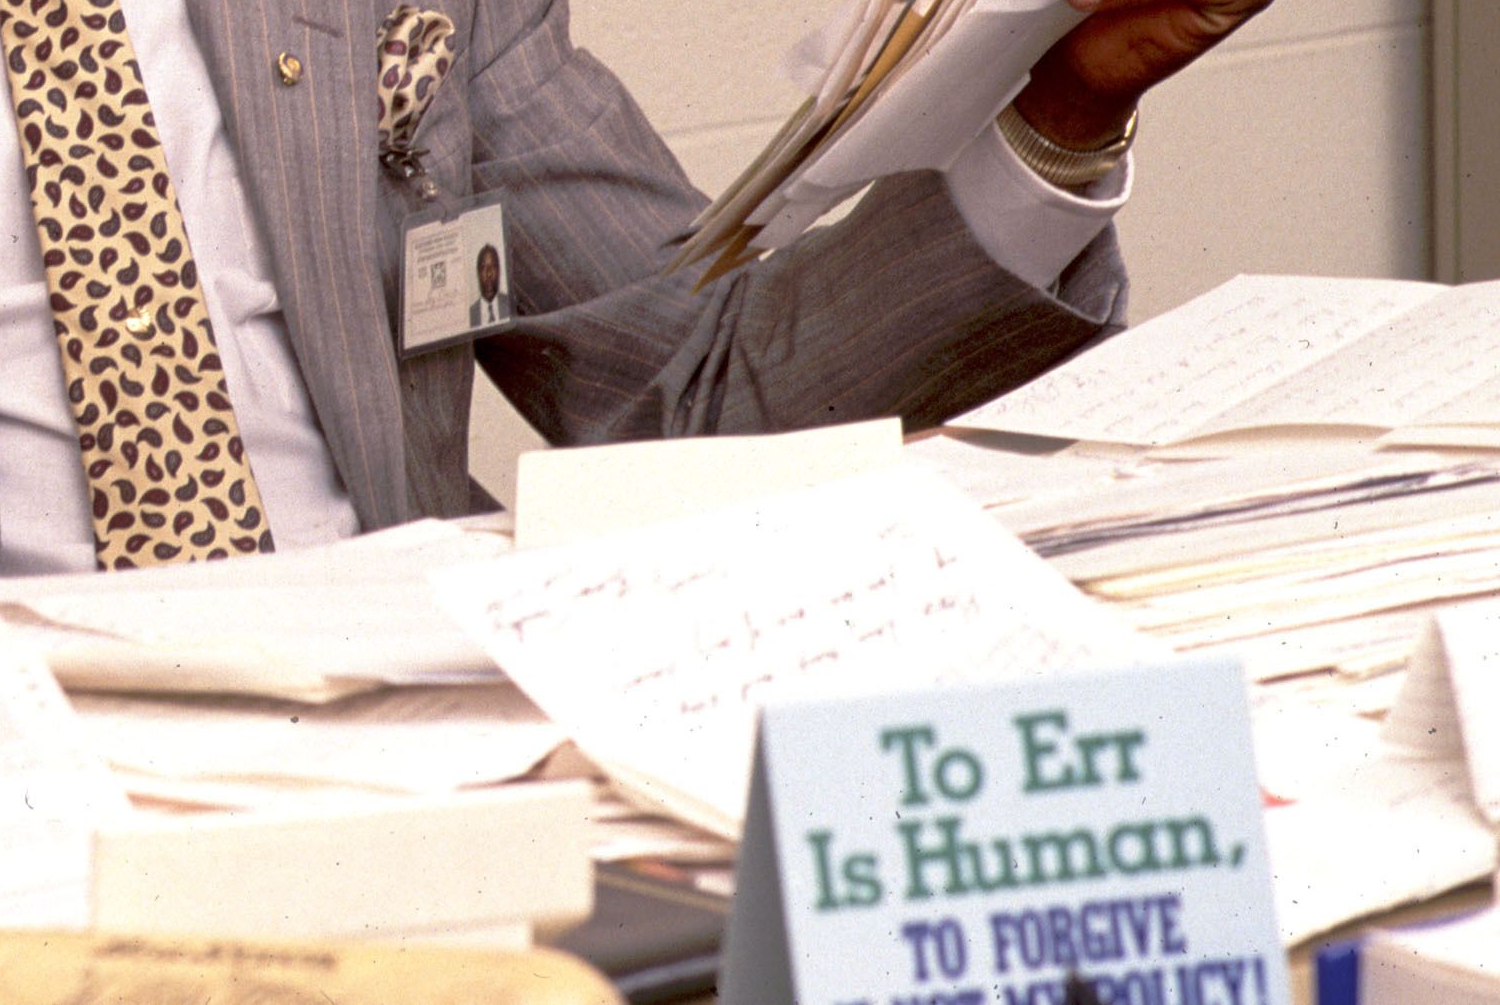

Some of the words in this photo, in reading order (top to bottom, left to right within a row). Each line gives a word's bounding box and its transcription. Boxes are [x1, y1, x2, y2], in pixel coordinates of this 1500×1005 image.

[880, 723, 984, 807] To
[1013, 710, 1146, 794] Err
[805, 826, 884, 911] Is
[896, 813, 1245, 902] Human,
[902, 917, 967, 983] TO
[989, 894, 1187, 975] FORGIVE
